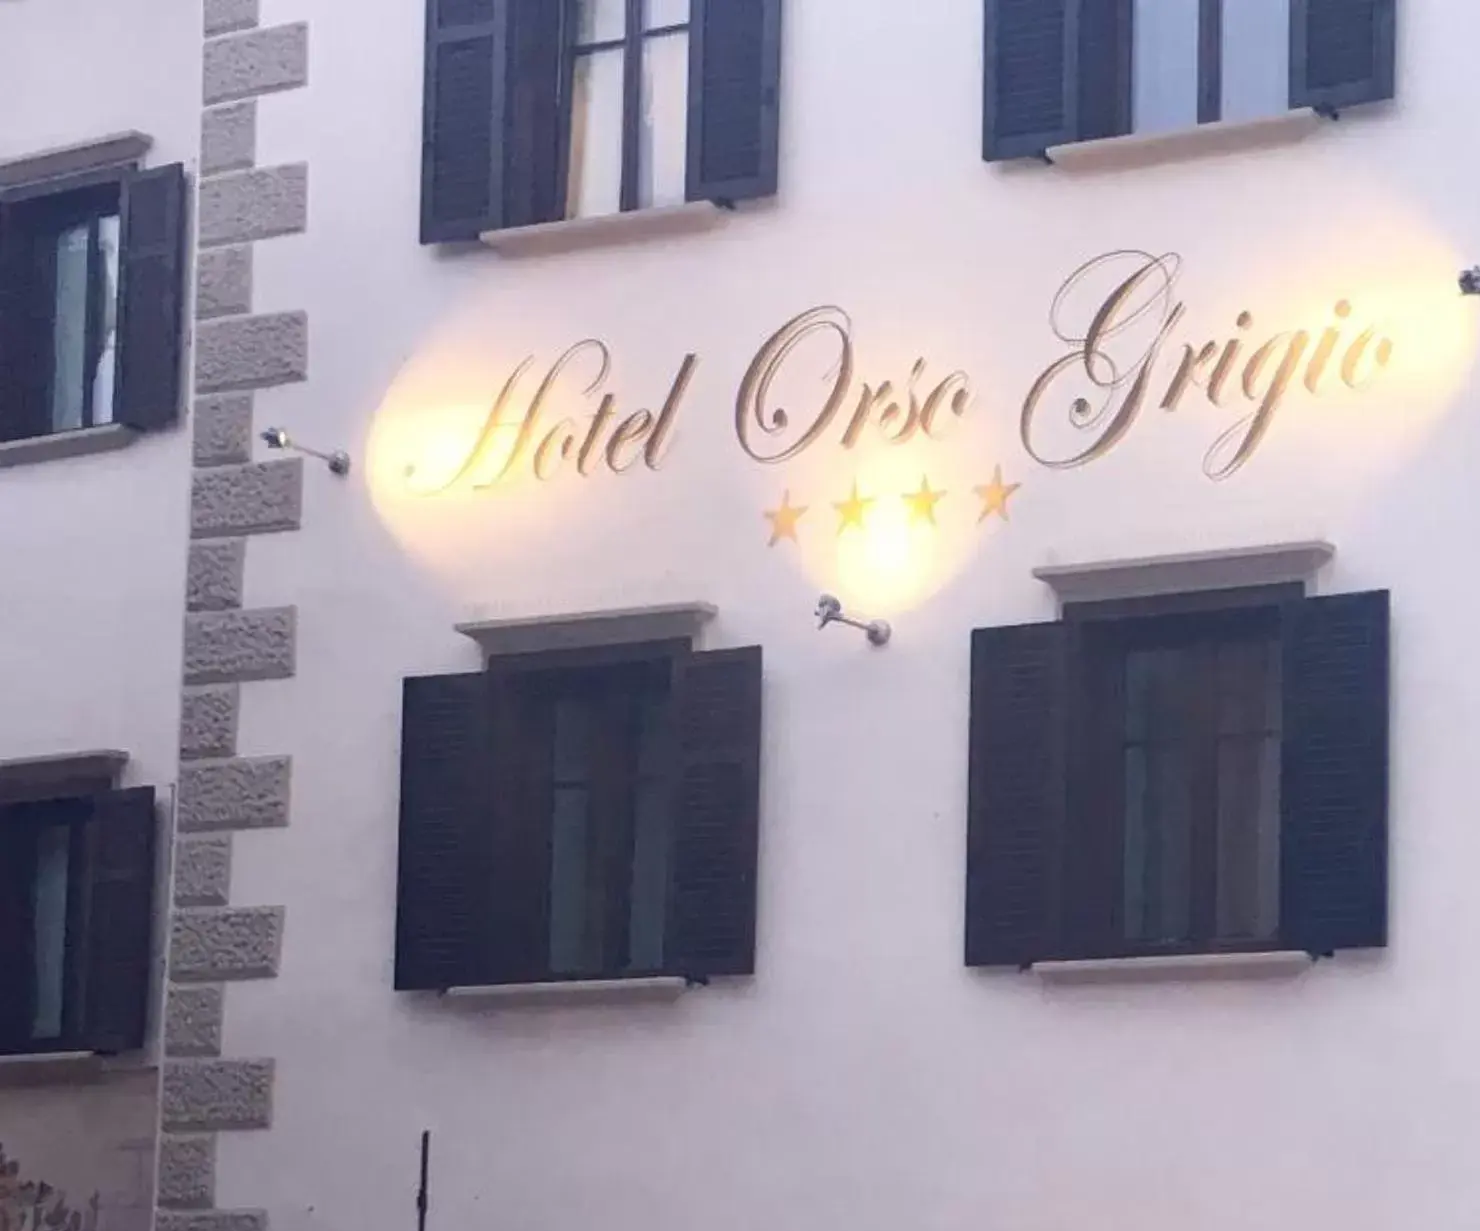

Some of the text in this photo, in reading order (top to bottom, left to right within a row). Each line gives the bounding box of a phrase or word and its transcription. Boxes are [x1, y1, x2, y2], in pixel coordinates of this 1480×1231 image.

[403, 249, 1394, 496] Hotel Orso Grigio
